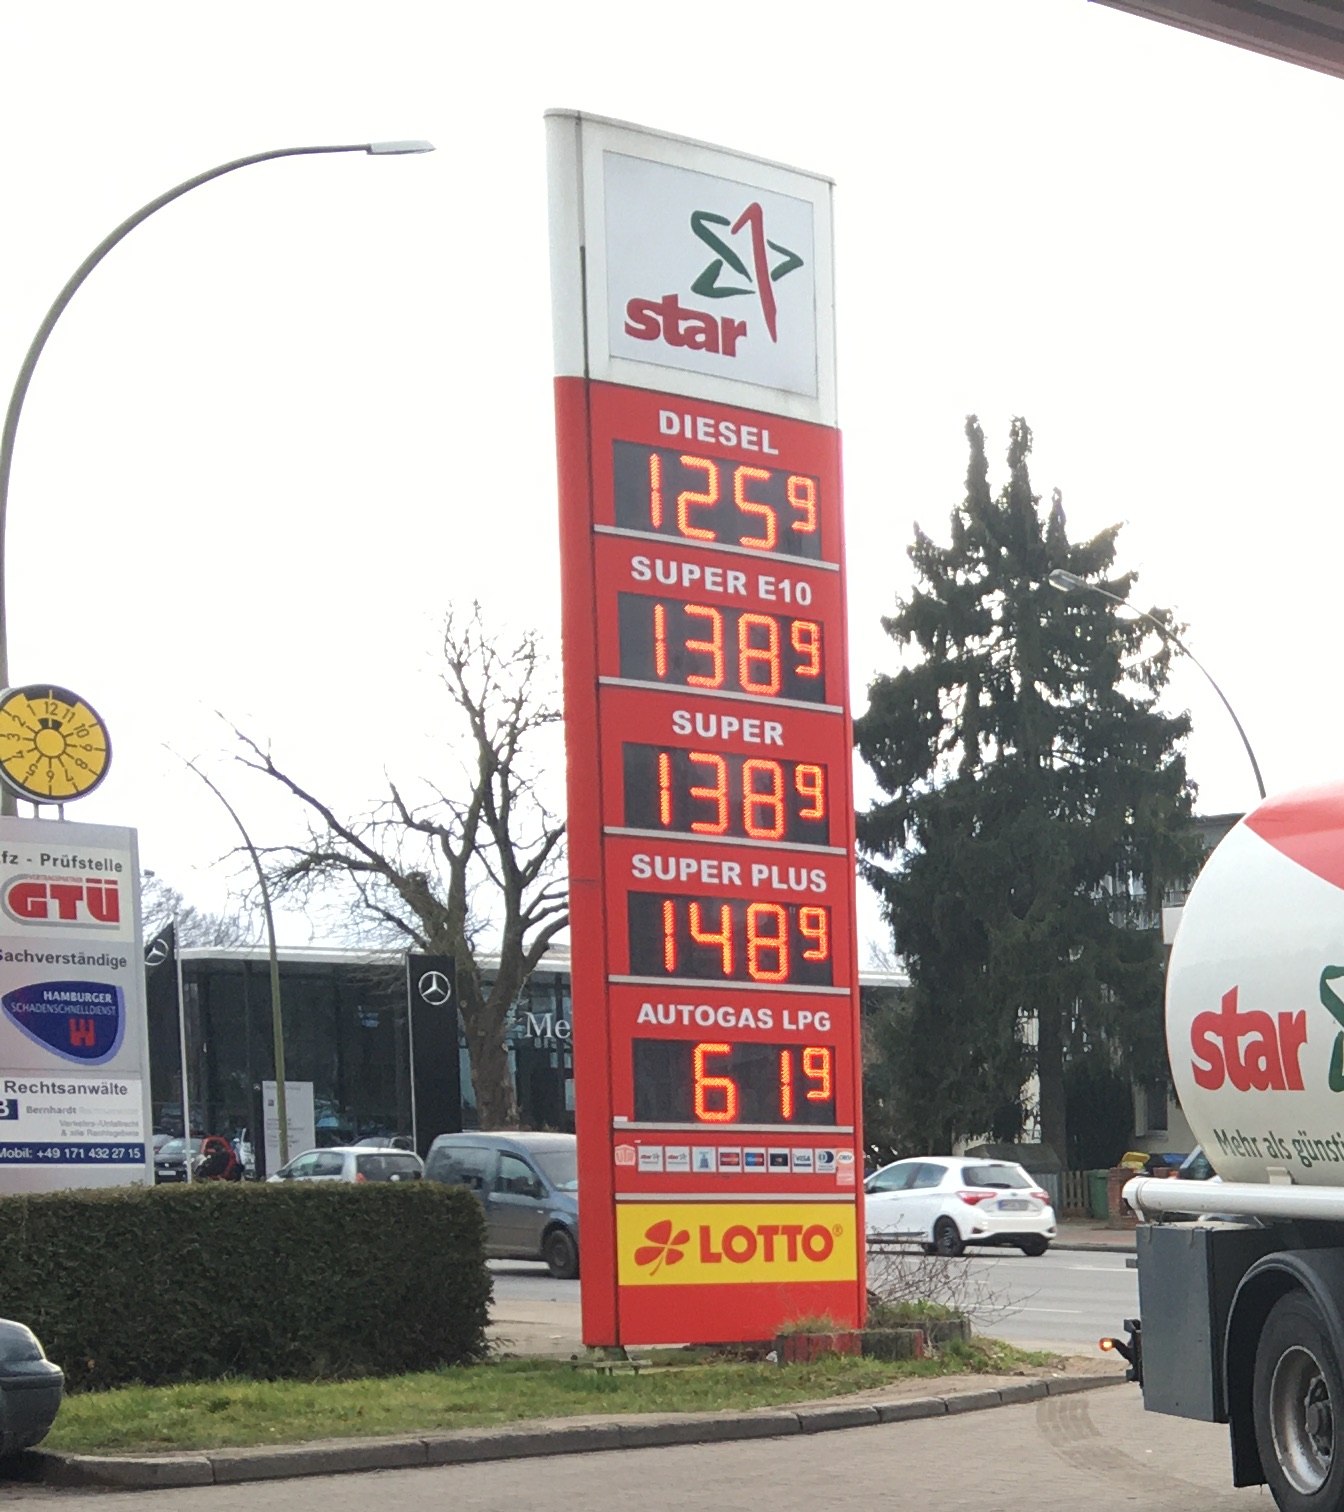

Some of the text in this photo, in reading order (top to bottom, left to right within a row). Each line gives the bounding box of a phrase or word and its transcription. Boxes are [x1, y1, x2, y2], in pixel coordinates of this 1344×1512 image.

[624, 293, 748, 358] star
[659, 409, 779, 455] DIESEL
[631, 555, 812, 607] SUPER E10
[44, 701, 59, 716] 12
[672, 709, 784, 746] SUPER
[40, 852, 123, 873] Prüfstelle
[631, 853, 828, 893] SUPER PLUS
[8, 877, 120, 924] GTÜ
[10, 1001, 117, 1017] SCHADENSCHNELLDIENST
[43, 990, 113, 1004] HAMBURGER
[637, 1002, 832, 1032] AUTOGAS LPG
[1190, 985, 1308, 1092] star
[4, 1079, 128, 1096] Rechtsanwälte
[26, 1105, 77, 1115] Bernhardt
[37, 1147, 61, 1159] +49
[65, 1147, 85, 1159] 171
[88, 1147, 109, 1159] 432
[111, 1147, 126, 1159] 27
[129, 1147, 141, 1159] 15
[1212, 1128, 1258, 1161] Mehr
[1262, 1130, 1292, 1161] als
[699, 1223, 834, 1264] LOTTO
